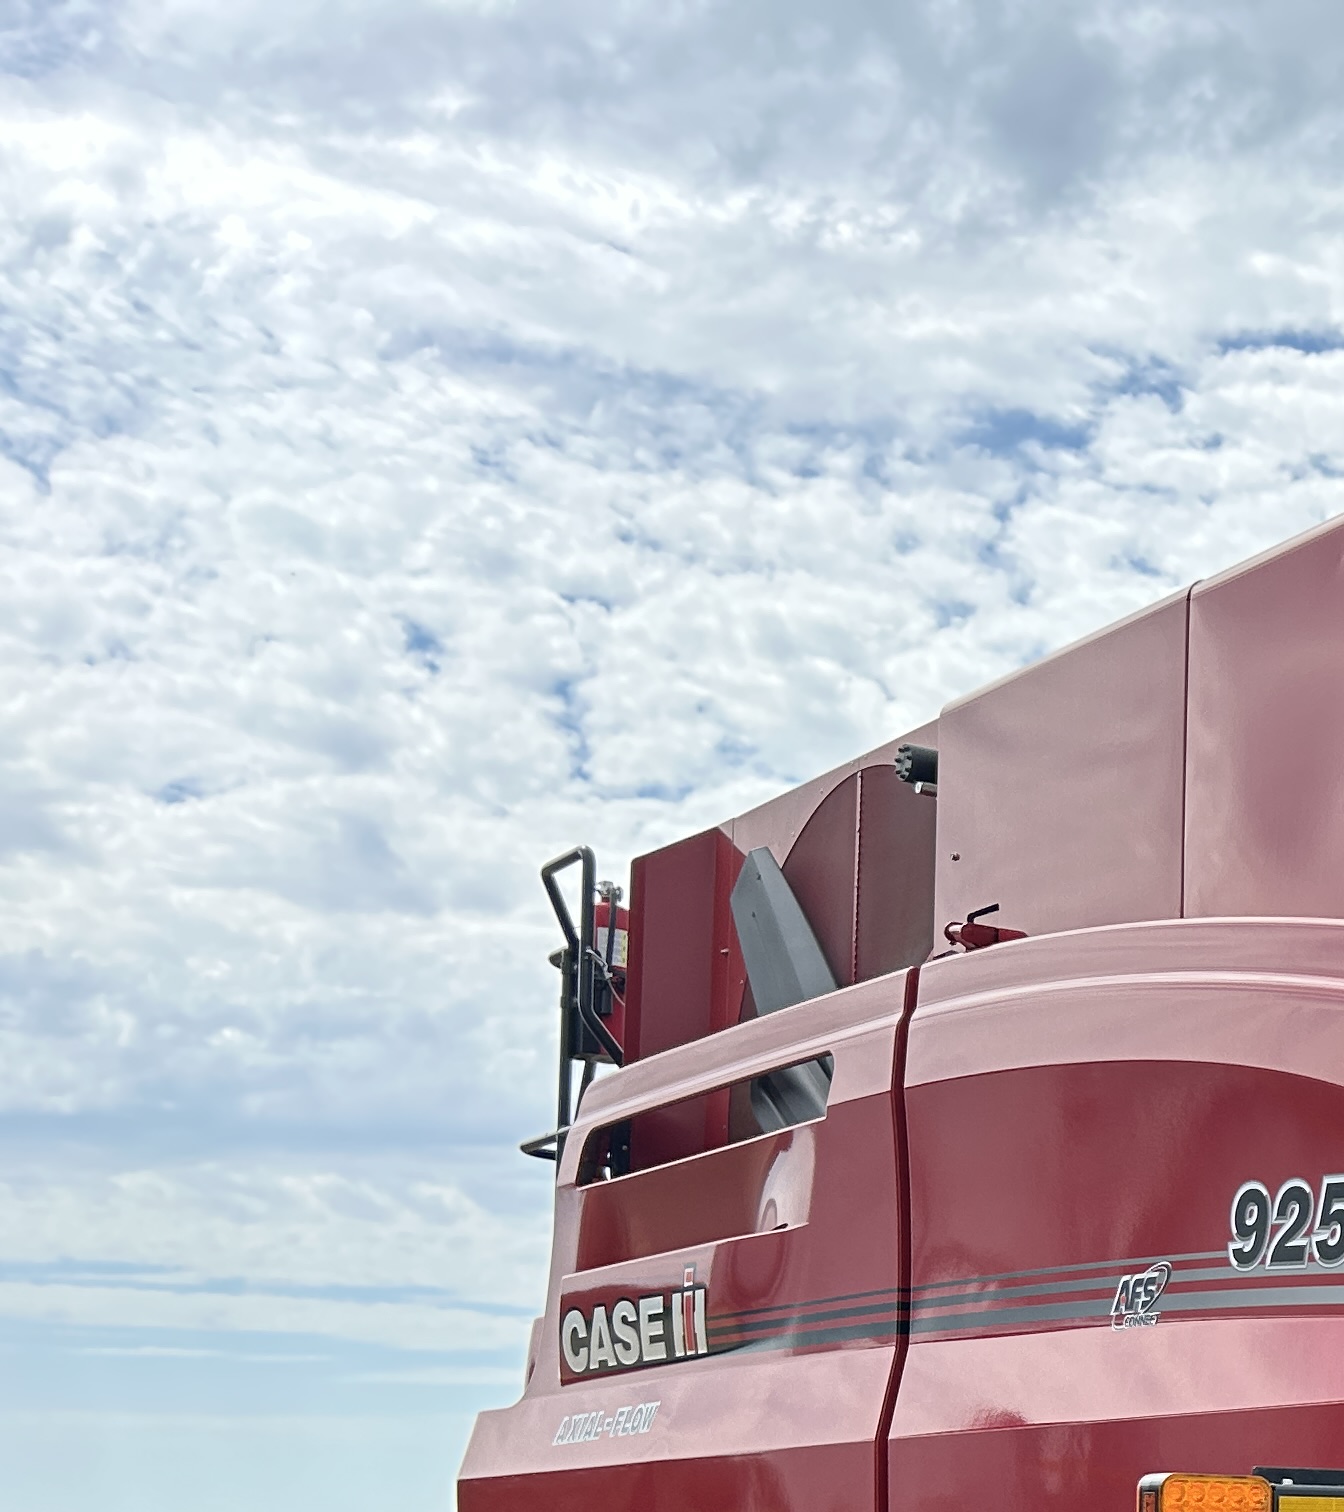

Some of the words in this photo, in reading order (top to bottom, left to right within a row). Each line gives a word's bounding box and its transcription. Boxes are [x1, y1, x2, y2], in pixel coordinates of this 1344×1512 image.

[1110, 1272, 1160, 1316] AFS
[562, 1296, 667, 1373] CASE
[552, 1401, 661, 1446] AXIAL-FLOW
